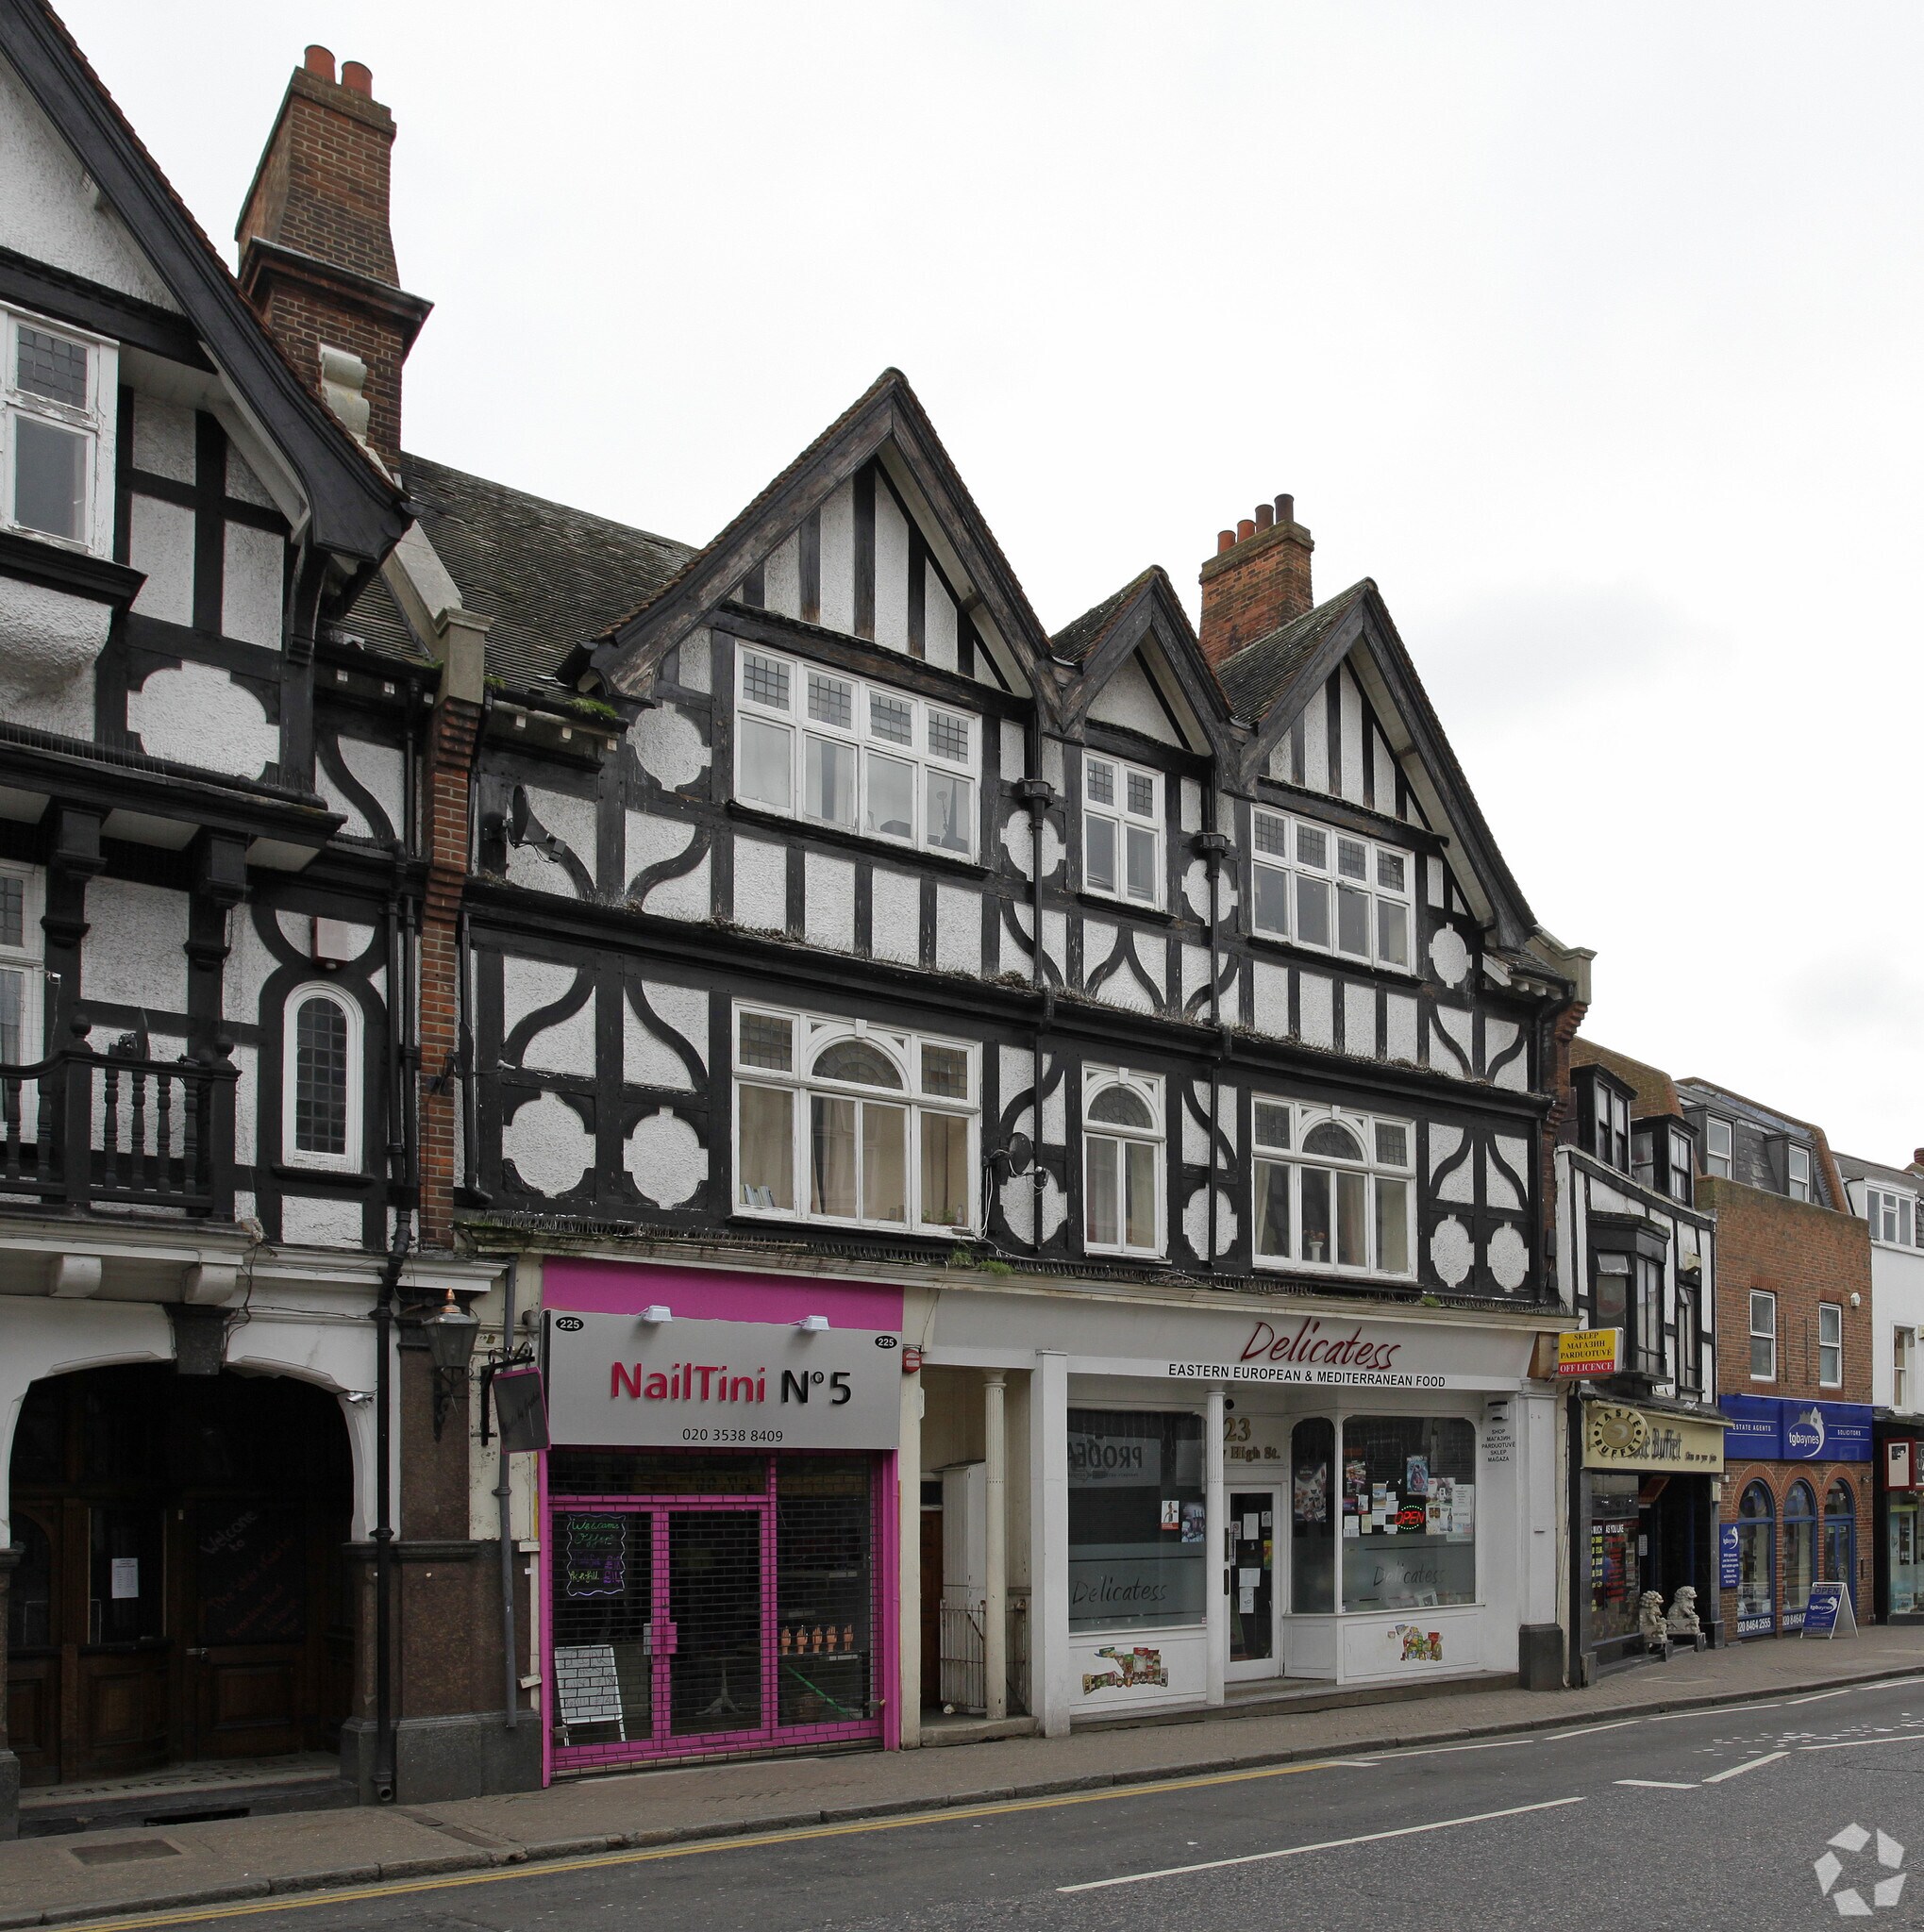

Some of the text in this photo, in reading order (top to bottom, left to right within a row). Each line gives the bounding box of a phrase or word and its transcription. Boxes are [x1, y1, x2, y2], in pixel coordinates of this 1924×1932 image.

[560, 1319, 580, 1330] 225
[878, 1338, 895, 1348] 225
[1241, 1316, 1400, 1370] Delicatess
[1574, 1332, 1598, 1341] SKLEP
[1567, 1341, 1605, 1349] МАГАЗИН
[1168, 1363, 1446, 1387] EASTERN EUROPEAN & MEDITERRANEAN FOOD
[1560, 1362, 1613, 1373] OFF LICENCE
[611, 1360, 766, 1403] NailTini
[1595, 1408, 1641, 1427] TASTE
[1732, 1423, 1751, 1431] ESTATE
[682, 1429, 784, 1442] 020 3538 8409
[1789, 1432, 1820, 1447] tgbaynes
[1595, 1438, 1641, 1457] BUFFET
[1651, 1427, 1682, 1461] Buffet
[1230, 1446, 1261, 1462] High
[1264, 1446, 1281, 1459] St.
[1395, 1510, 1426, 1525] OPEN
[229, 1539, 245, 1552] to
[1072, 1574, 1167, 1605] Delicatess
[1746, 1619, 1759, 1631] 8464
[1759, 1617, 1771, 1629] 2555
